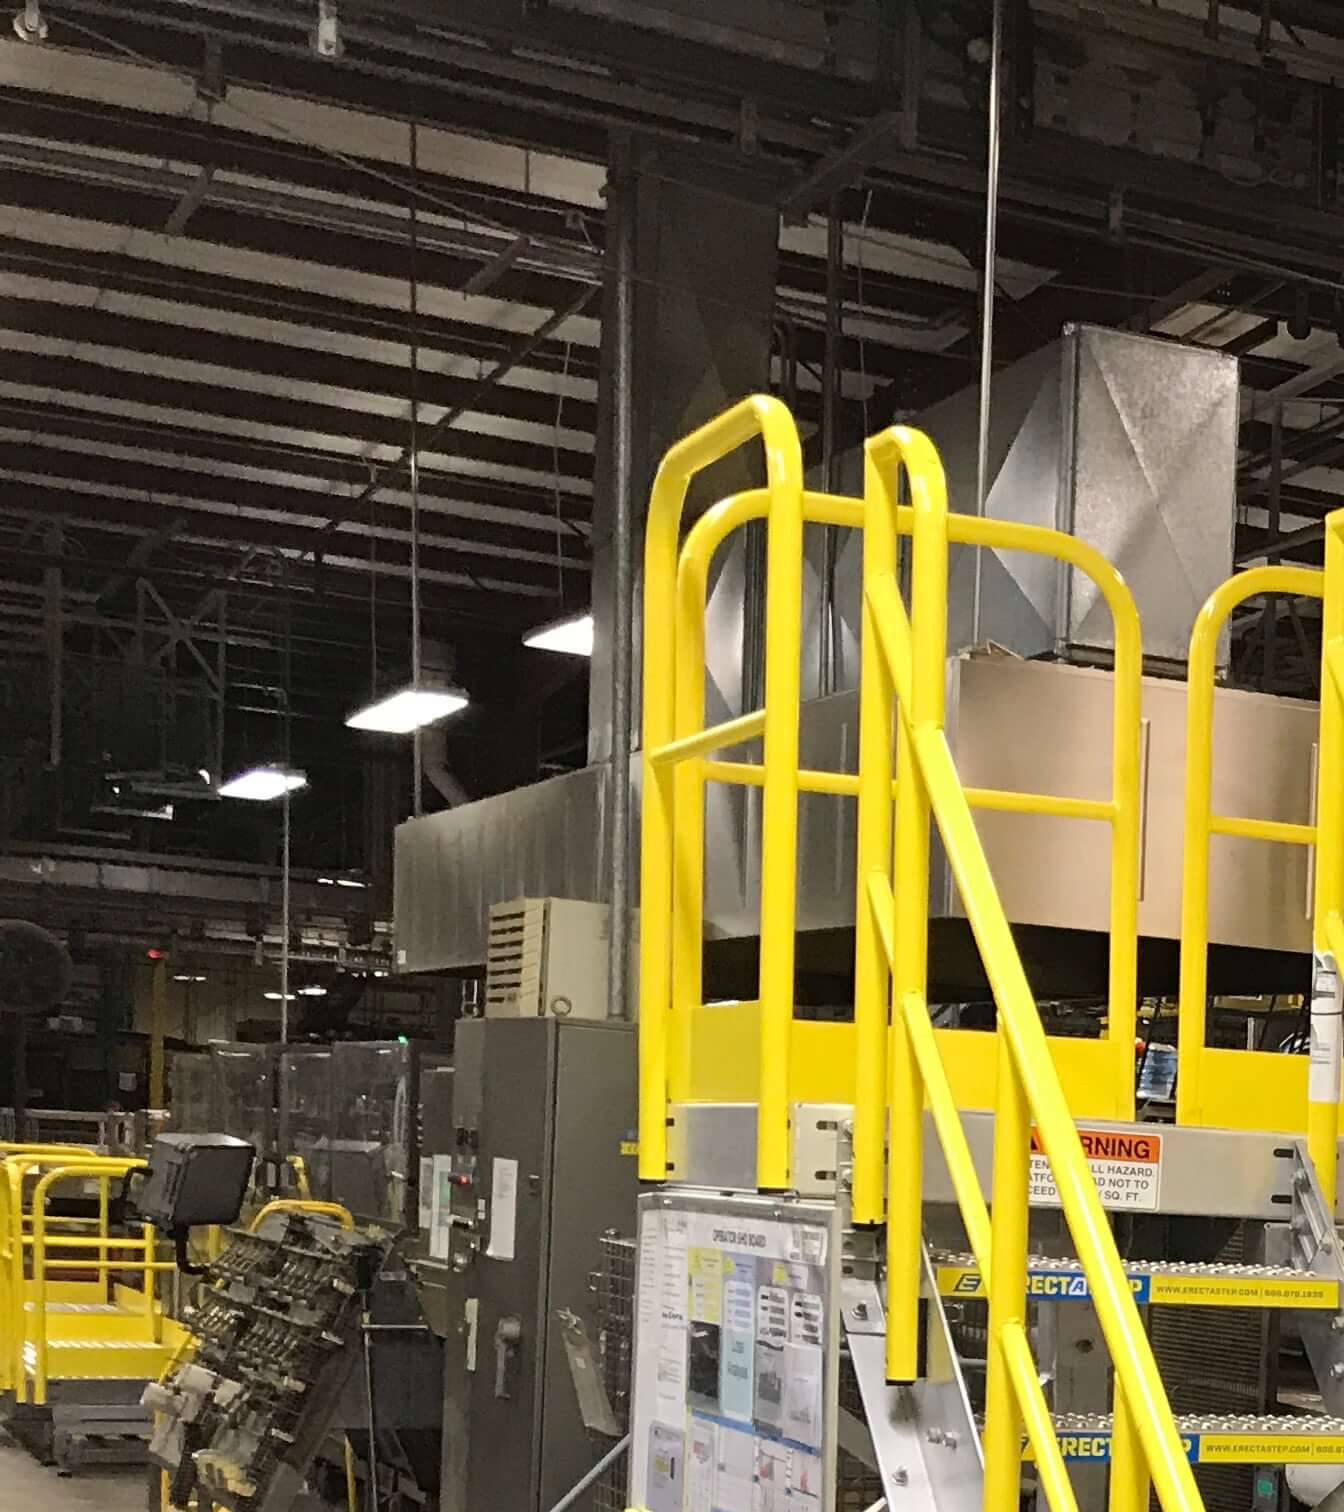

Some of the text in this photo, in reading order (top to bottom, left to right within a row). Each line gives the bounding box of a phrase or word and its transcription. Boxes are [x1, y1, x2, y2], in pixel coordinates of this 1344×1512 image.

[1080, 1136, 1150, 1159] RNING
[1108, 1178, 1131, 1189] NOT
[1135, 1180, 1149, 1190] TO
